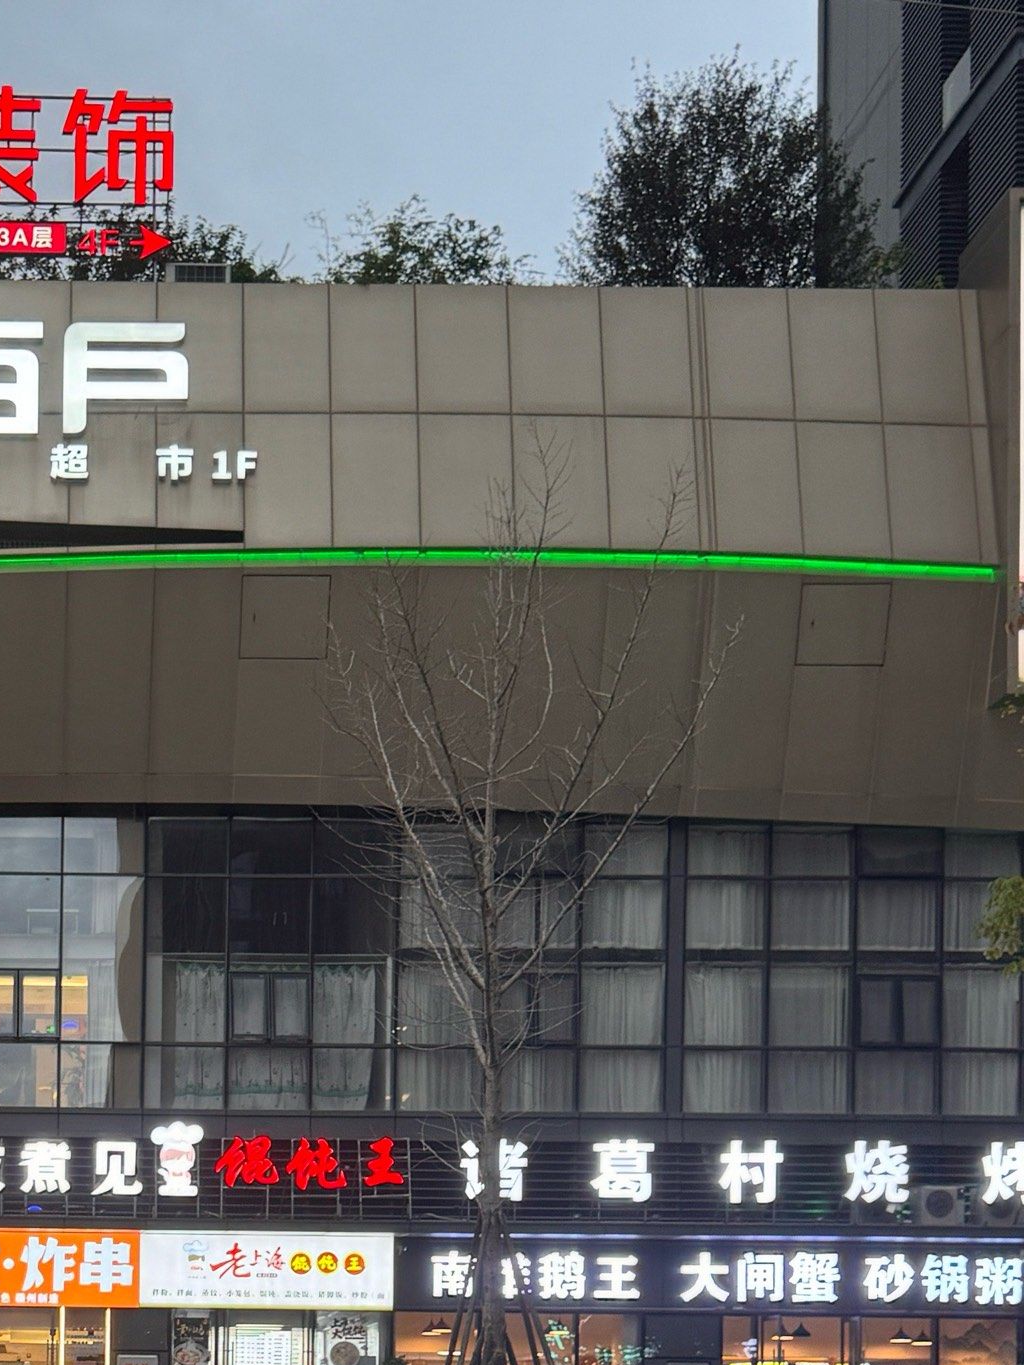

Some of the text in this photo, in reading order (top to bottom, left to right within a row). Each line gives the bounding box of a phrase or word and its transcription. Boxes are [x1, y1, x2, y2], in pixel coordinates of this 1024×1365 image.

[78, 229, 120, 256] 4F
[209, 1242, 286, 1279] 老上海
[679, 1251, 841, 1303] 大闸蟹
[863, 1253, 1024, 1306] 砂锅粥
